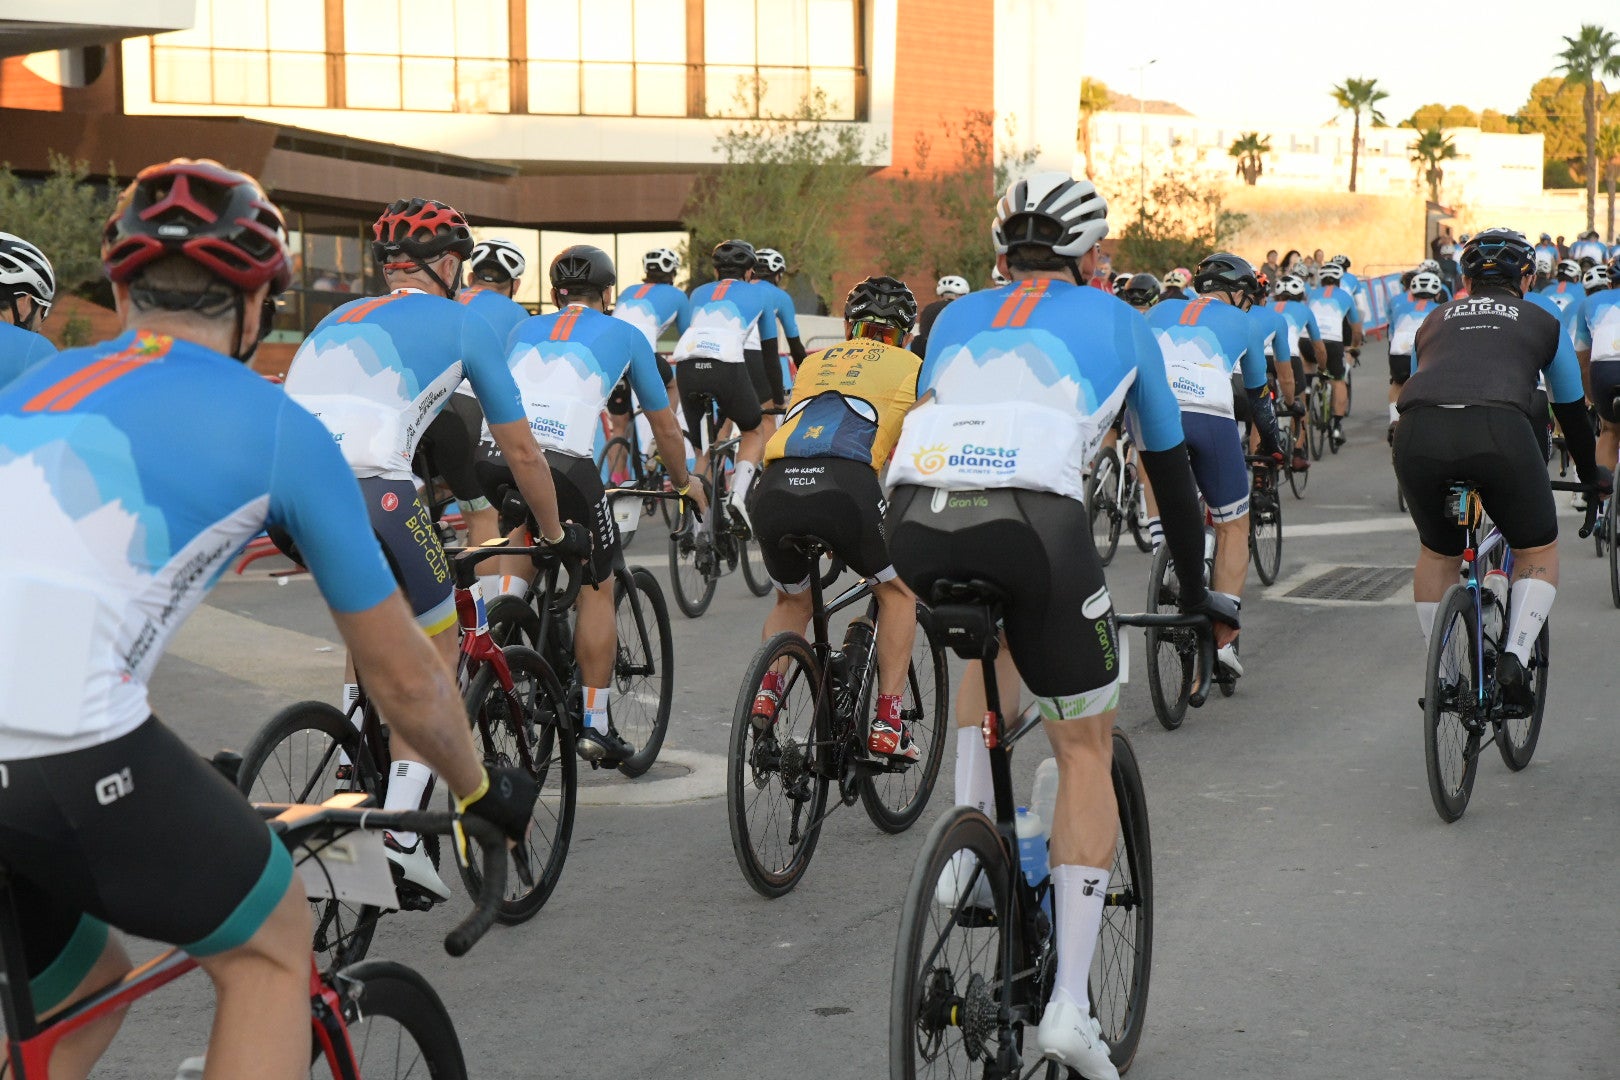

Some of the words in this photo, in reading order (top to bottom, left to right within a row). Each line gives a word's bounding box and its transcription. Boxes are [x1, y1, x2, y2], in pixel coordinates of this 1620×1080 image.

[535, 416, 567, 430] Costa
[962, 444, 1020, 458] Costa
[948, 455, 1016, 468] Blanca
[788, 477, 816, 486] YECLA
[948, 498, 972, 508] Gran
[594, 501, 609, 550] PHARMA
[405, 516, 446, 583] BICI-CLUB
[1095, 620, 1110, 651] Gran
